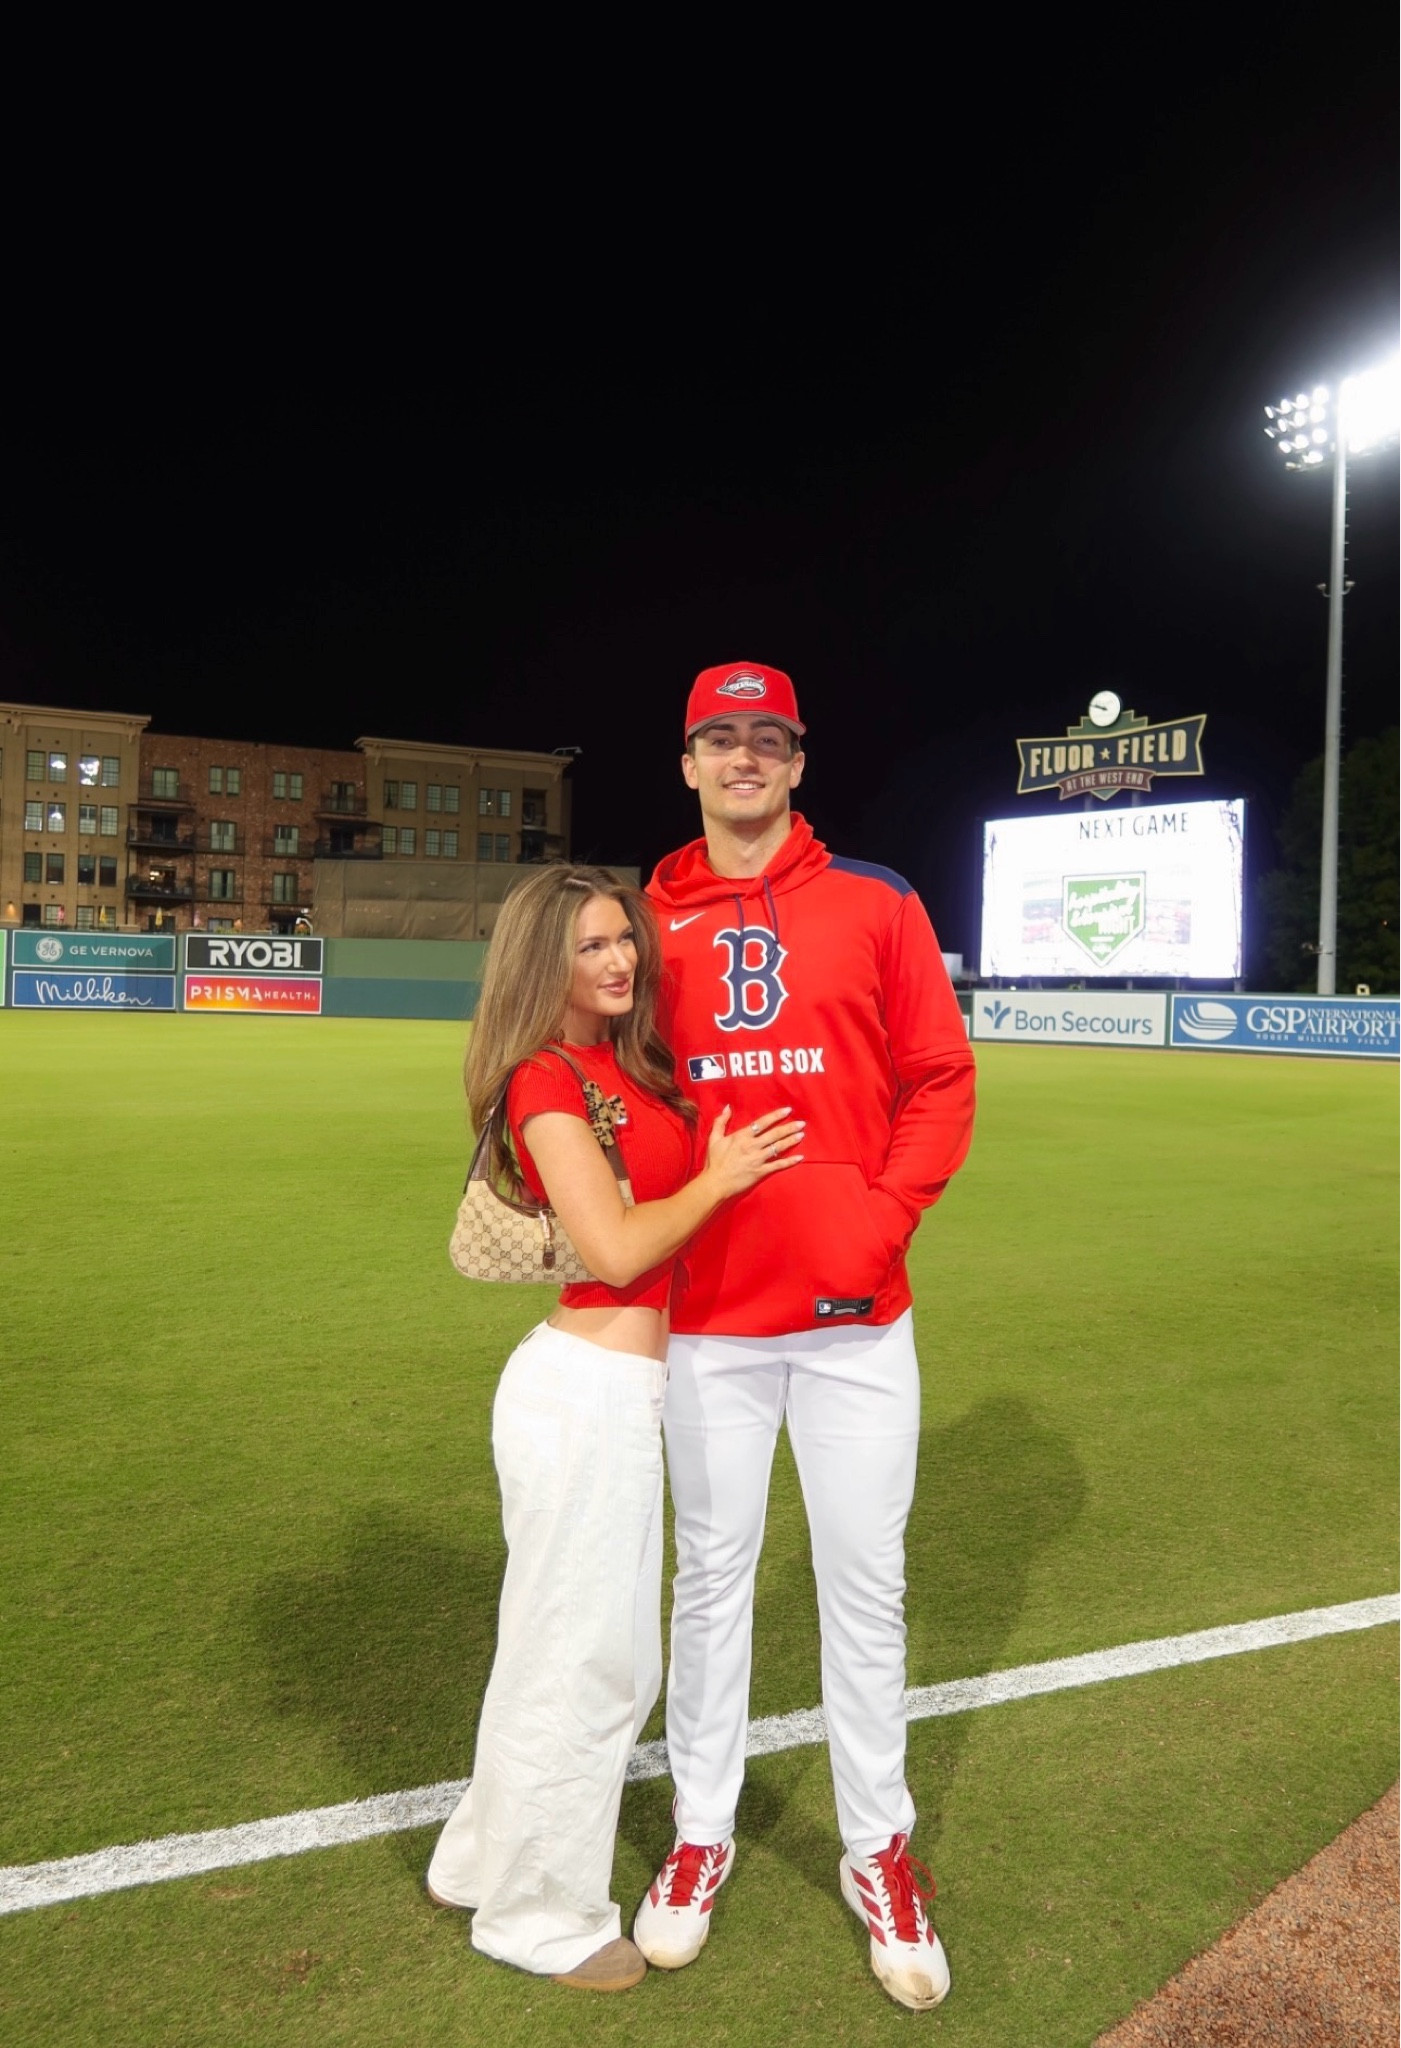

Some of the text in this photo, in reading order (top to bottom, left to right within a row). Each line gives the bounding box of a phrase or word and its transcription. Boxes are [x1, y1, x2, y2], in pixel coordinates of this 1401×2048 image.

[1030, 729, 1188, 778] FLUOR FIELD
[1065, 772, 1144, 792] AT THE WEST END
[1079, 812, 1189, 840] NEXT GAME
[69, 945, 154, 957] GE VERNOVA
[208, 940, 302, 968] RYOBI
[36, 977, 153, 1006] Milliken
[713, 925, 789, 1032] B
[190, 985, 263, 1001] PRISMA
[1015, 1009, 1153, 1036] Bon Secours
[1246, 1006, 1397, 1034] GSP INTERNATIONAL
[1302, 1018, 1400, 1038] AIRPORT
[1297, 1035, 1349, 1043] MILLIKEN
[1357, 1038, 1390, 1046] FIELD
[729, 1047, 825, 1078] RED SOX
